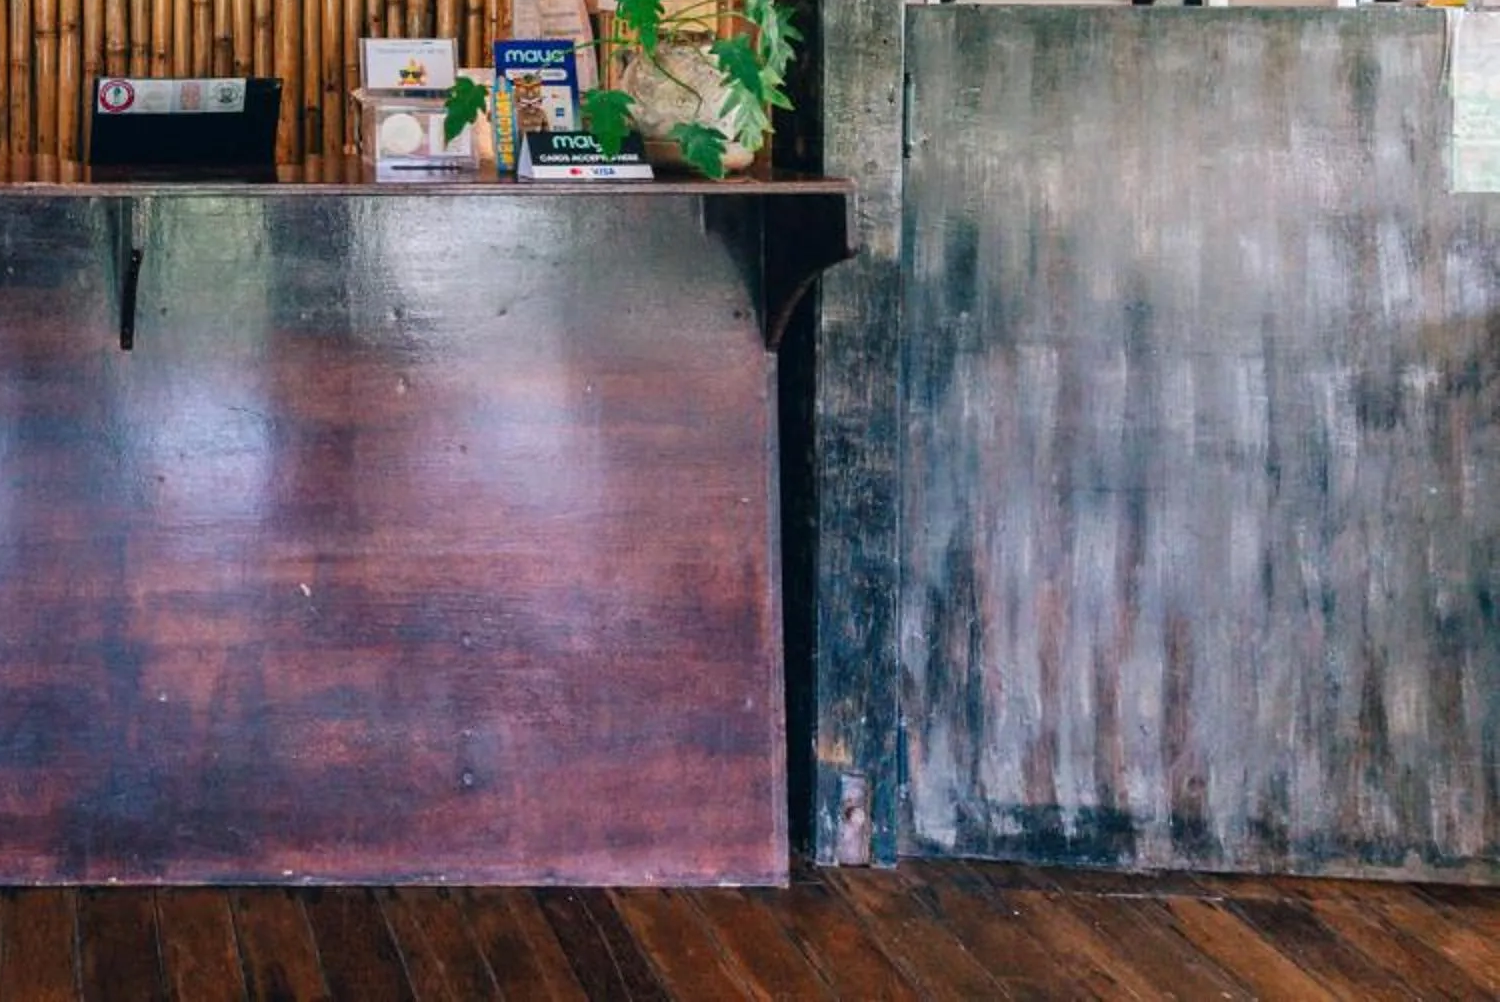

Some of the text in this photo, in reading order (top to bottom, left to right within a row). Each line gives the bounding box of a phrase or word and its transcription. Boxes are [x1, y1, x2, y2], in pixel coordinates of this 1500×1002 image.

[505, 49, 566, 66] maya
[552, 135, 603, 152] may
[592, 167, 616, 175] VISA
